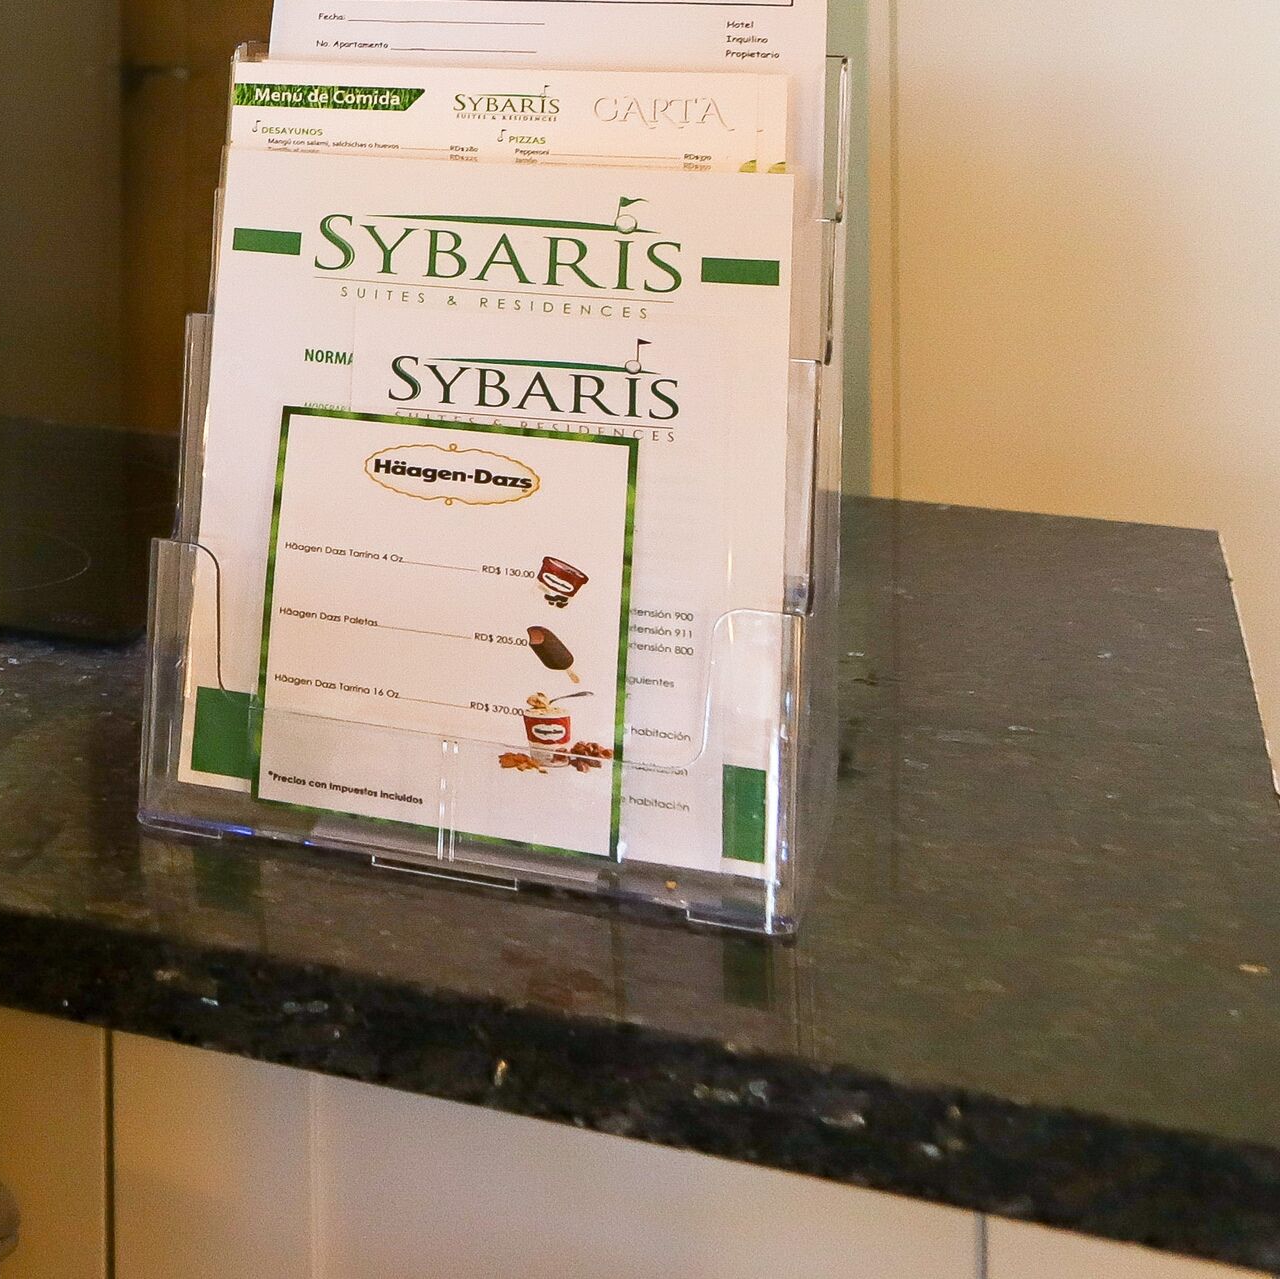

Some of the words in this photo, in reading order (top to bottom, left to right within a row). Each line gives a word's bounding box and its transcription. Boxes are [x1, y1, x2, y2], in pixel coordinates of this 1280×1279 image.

[333, 41, 389, 49] Apartamento
[726, 35, 768, 44] Inquilino
[725, 49, 780, 59] Propietario
[255, 88, 303, 102] Menú
[308, 90, 329, 104] de
[333, 91, 401, 106] Comida
[453, 94, 560, 114] SYBARIS
[593, 95, 735, 131] CARTA
[261, 126, 323, 136] DESAYUNOS
[508, 135, 546, 145] PIZZAS
[314, 213, 682, 294] SYBARIS
[341, 286, 426, 304] SUITES
[447, 295, 457, 306] &
[480, 297, 648, 319] RESIDENCES
[388, 355, 680, 421] SYBARIS
[374, 459, 533, 489] Häagen-Dazs
[325, 546, 347, 556] Dazs
[349, 549, 380, 560] Tarrina
[382, 553, 388, 561] 4
[482, 565, 501, 575] RD$
[504, 568, 535, 578] 130.00
[630, 608, 672, 619] tensión
[674, 612, 694, 621] 900
[319, 612, 341, 623] Dazs
[344, 614, 378, 627] Paletas
[474, 632, 494, 644] RD$
[496, 635, 528, 647] 205.00
[629, 624, 672, 636] tensión
[674, 629, 693, 638] 911
[629, 642, 672, 653] tensión
[674, 646, 694, 656] 800
[627, 676, 675, 688] guientes
[315, 678, 337, 689] Dazs
[339, 681, 370, 695] Tarrina
[373, 687, 384, 697] 16
[470, 701, 490, 713] RD$
[492, 703, 524, 716] 370.00
[630, 726, 691, 742] habitación
[308, 779, 327, 790] con
